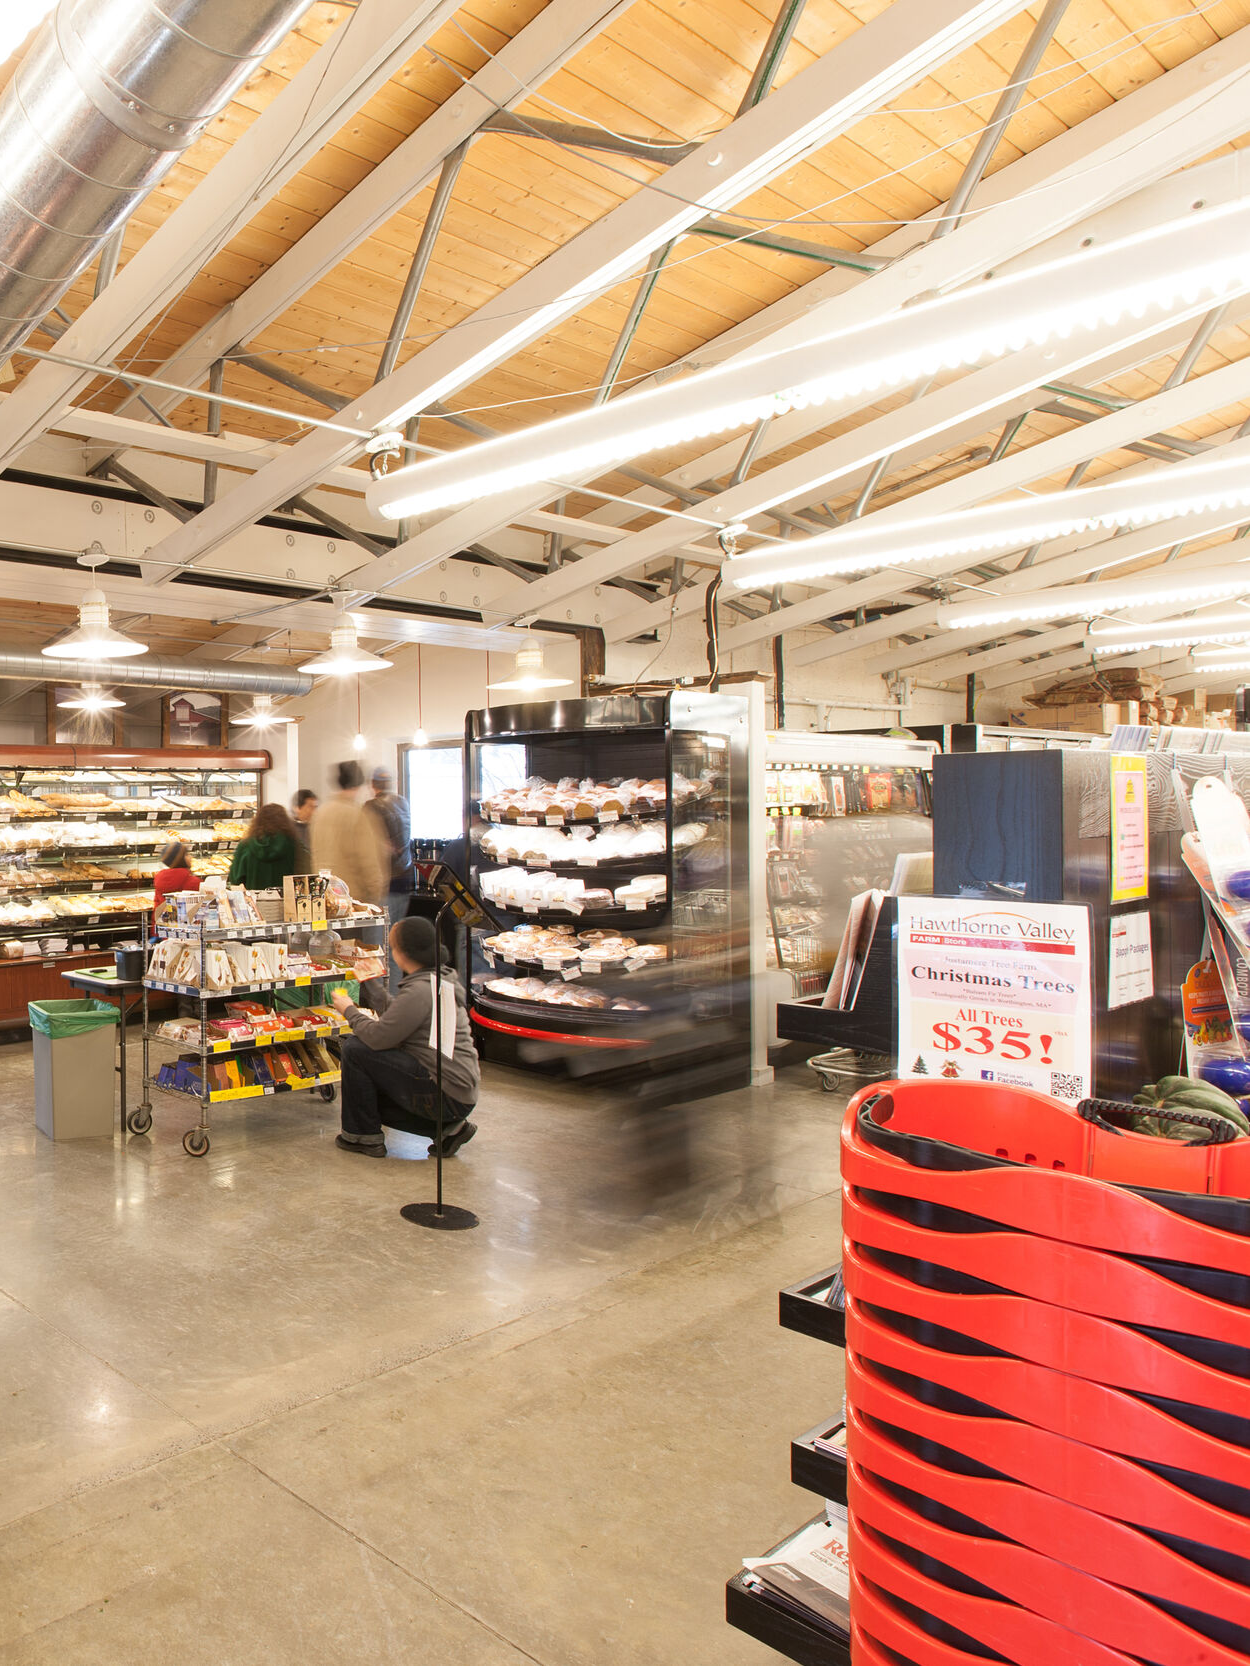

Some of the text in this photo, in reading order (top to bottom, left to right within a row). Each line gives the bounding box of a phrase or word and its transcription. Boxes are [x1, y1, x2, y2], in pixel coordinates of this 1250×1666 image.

[910, 915, 1075, 944] Hawthorne Valley
[912, 935, 967, 946] FARM Store
[911, 965, 1075, 994] Christmas Trees
[955, 1008, 1024, 1029] All Trees
[932, 1022, 1054, 1064] $35!
[997, 1076, 1034, 1087] Facebook
